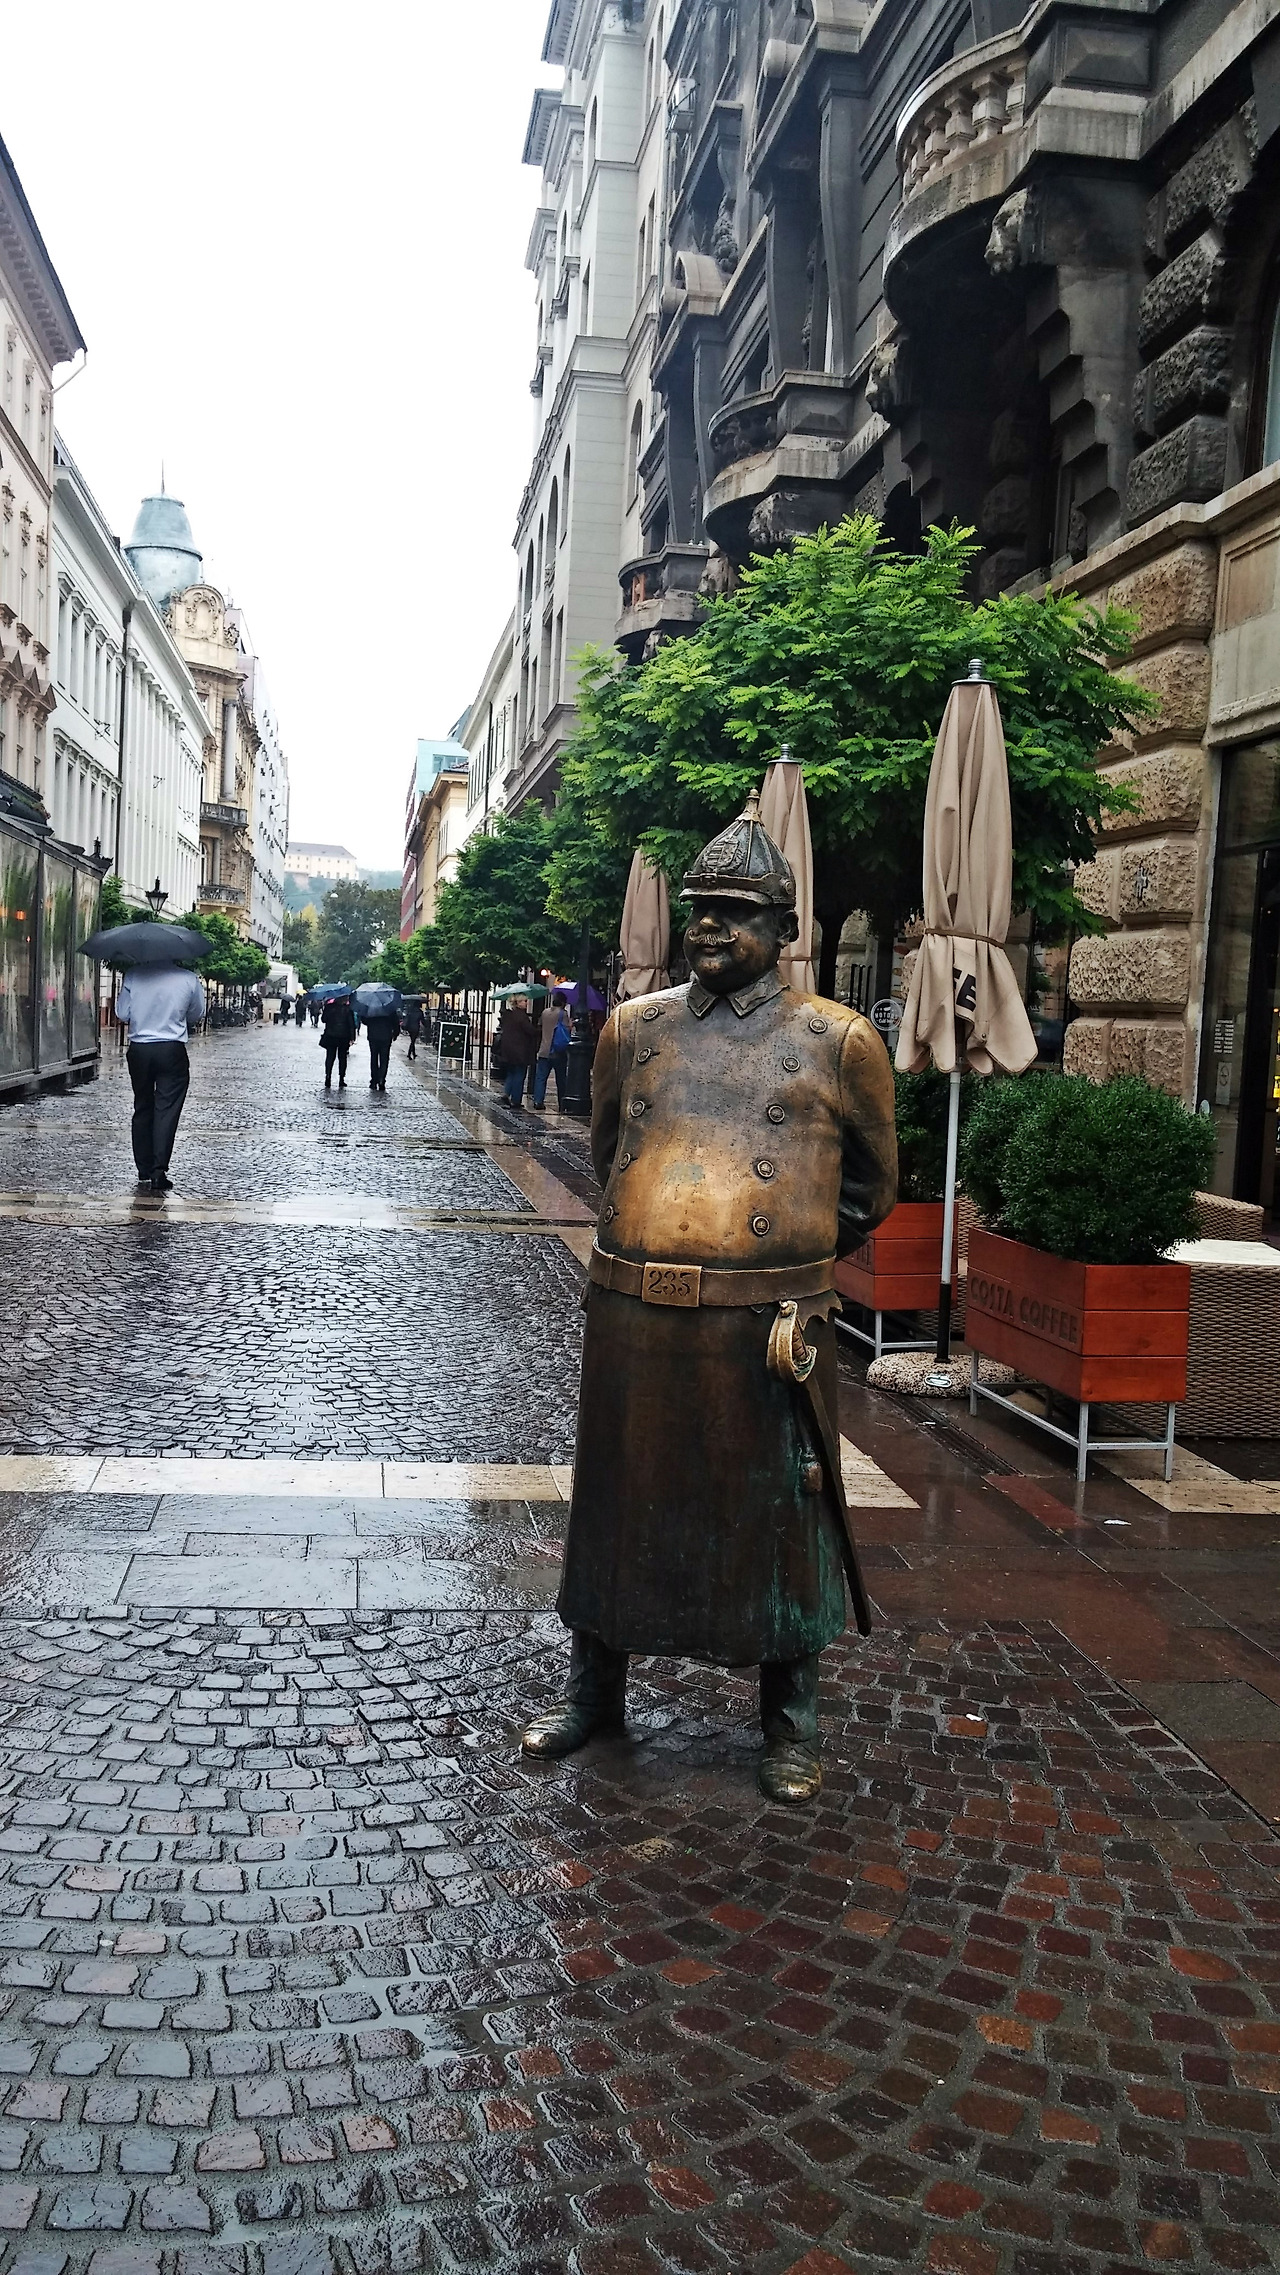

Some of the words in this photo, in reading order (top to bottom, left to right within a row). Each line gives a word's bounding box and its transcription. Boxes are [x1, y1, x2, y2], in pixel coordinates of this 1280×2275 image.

[648, 1270, 691, 1297] 235
[970, 1277, 1014, 1317] COSTA
[1020, 1296, 1077, 1344] COFFEE
